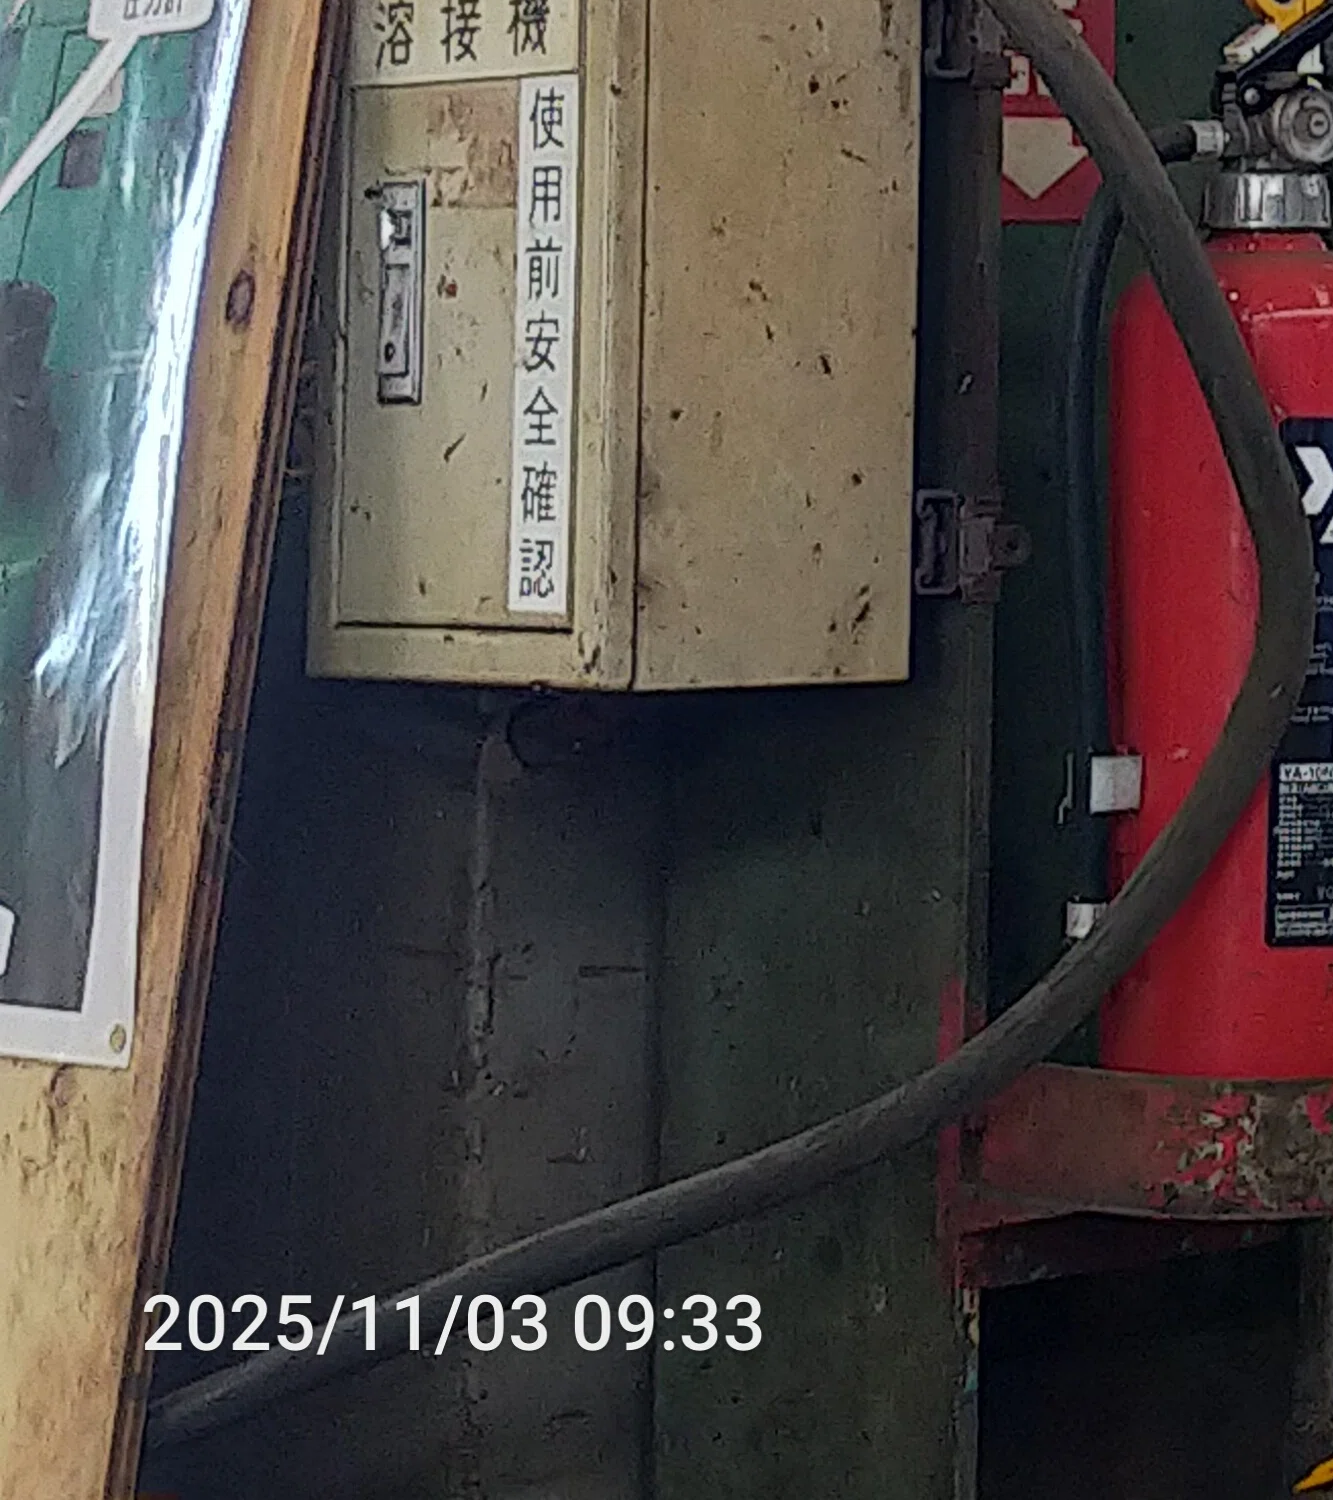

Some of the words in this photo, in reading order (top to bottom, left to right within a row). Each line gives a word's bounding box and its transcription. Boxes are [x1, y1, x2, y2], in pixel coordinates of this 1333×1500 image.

[518, 83, 567, 601] 使用前安全確認
